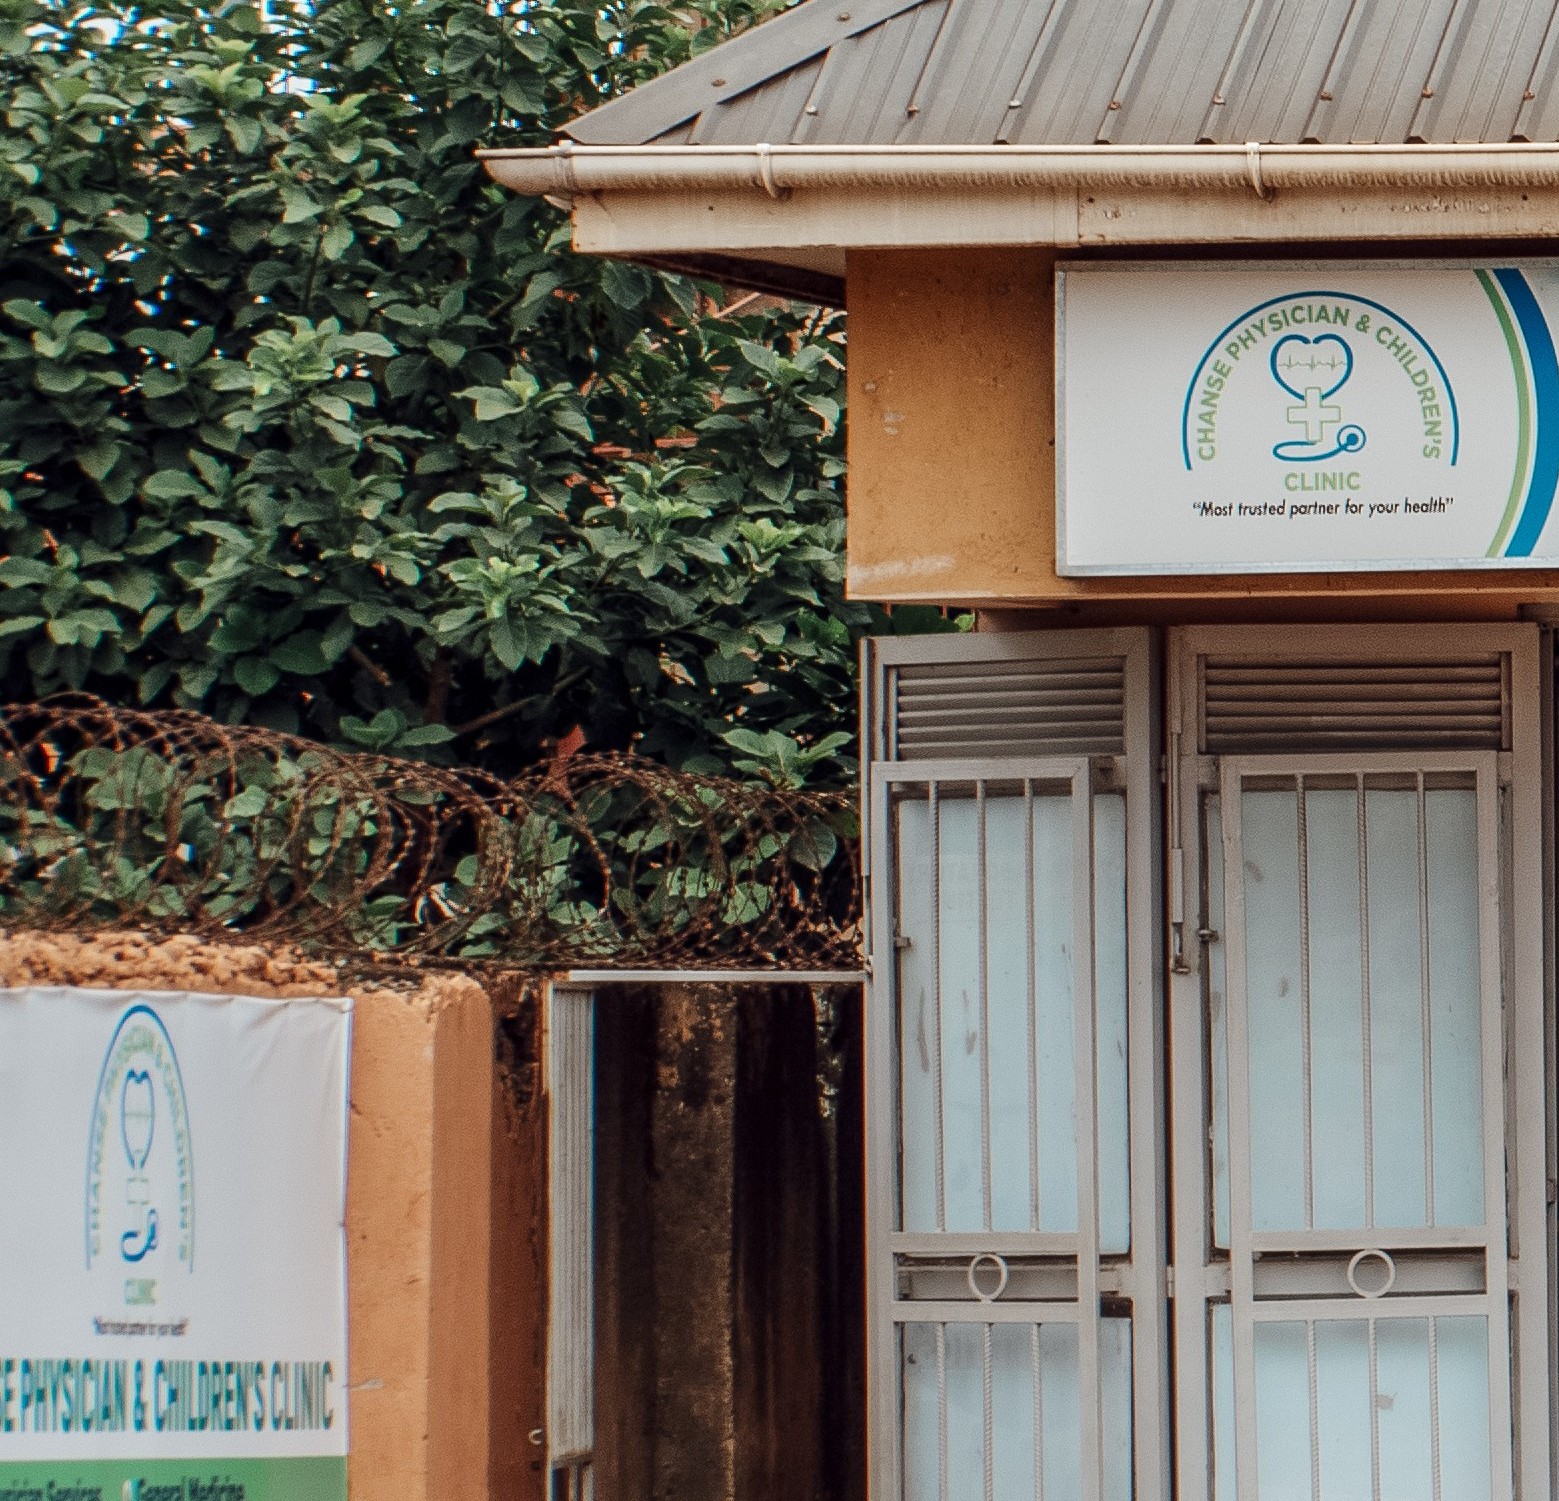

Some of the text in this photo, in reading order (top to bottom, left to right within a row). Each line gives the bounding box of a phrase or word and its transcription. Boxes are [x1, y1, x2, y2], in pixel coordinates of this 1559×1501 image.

[1197, 358, 1234, 462] CHANSE
[1225, 304, 1350, 361] PHYSICIAN
[1355, 314, 1372, 334] &
[1284, 471, 1362, 492] CLINIC
[1238, 499, 1286, 517] trusted
[1289, 500, 1340, 519] partner
[1344, 499, 1363, 515] for
[1368, 503, 1400, 518] your
[20, 1357, 127, 1433] PHYSICIAN
[132, 1357, 147, 1432] &
[270, 1358, 334, 1432] CLINIC
